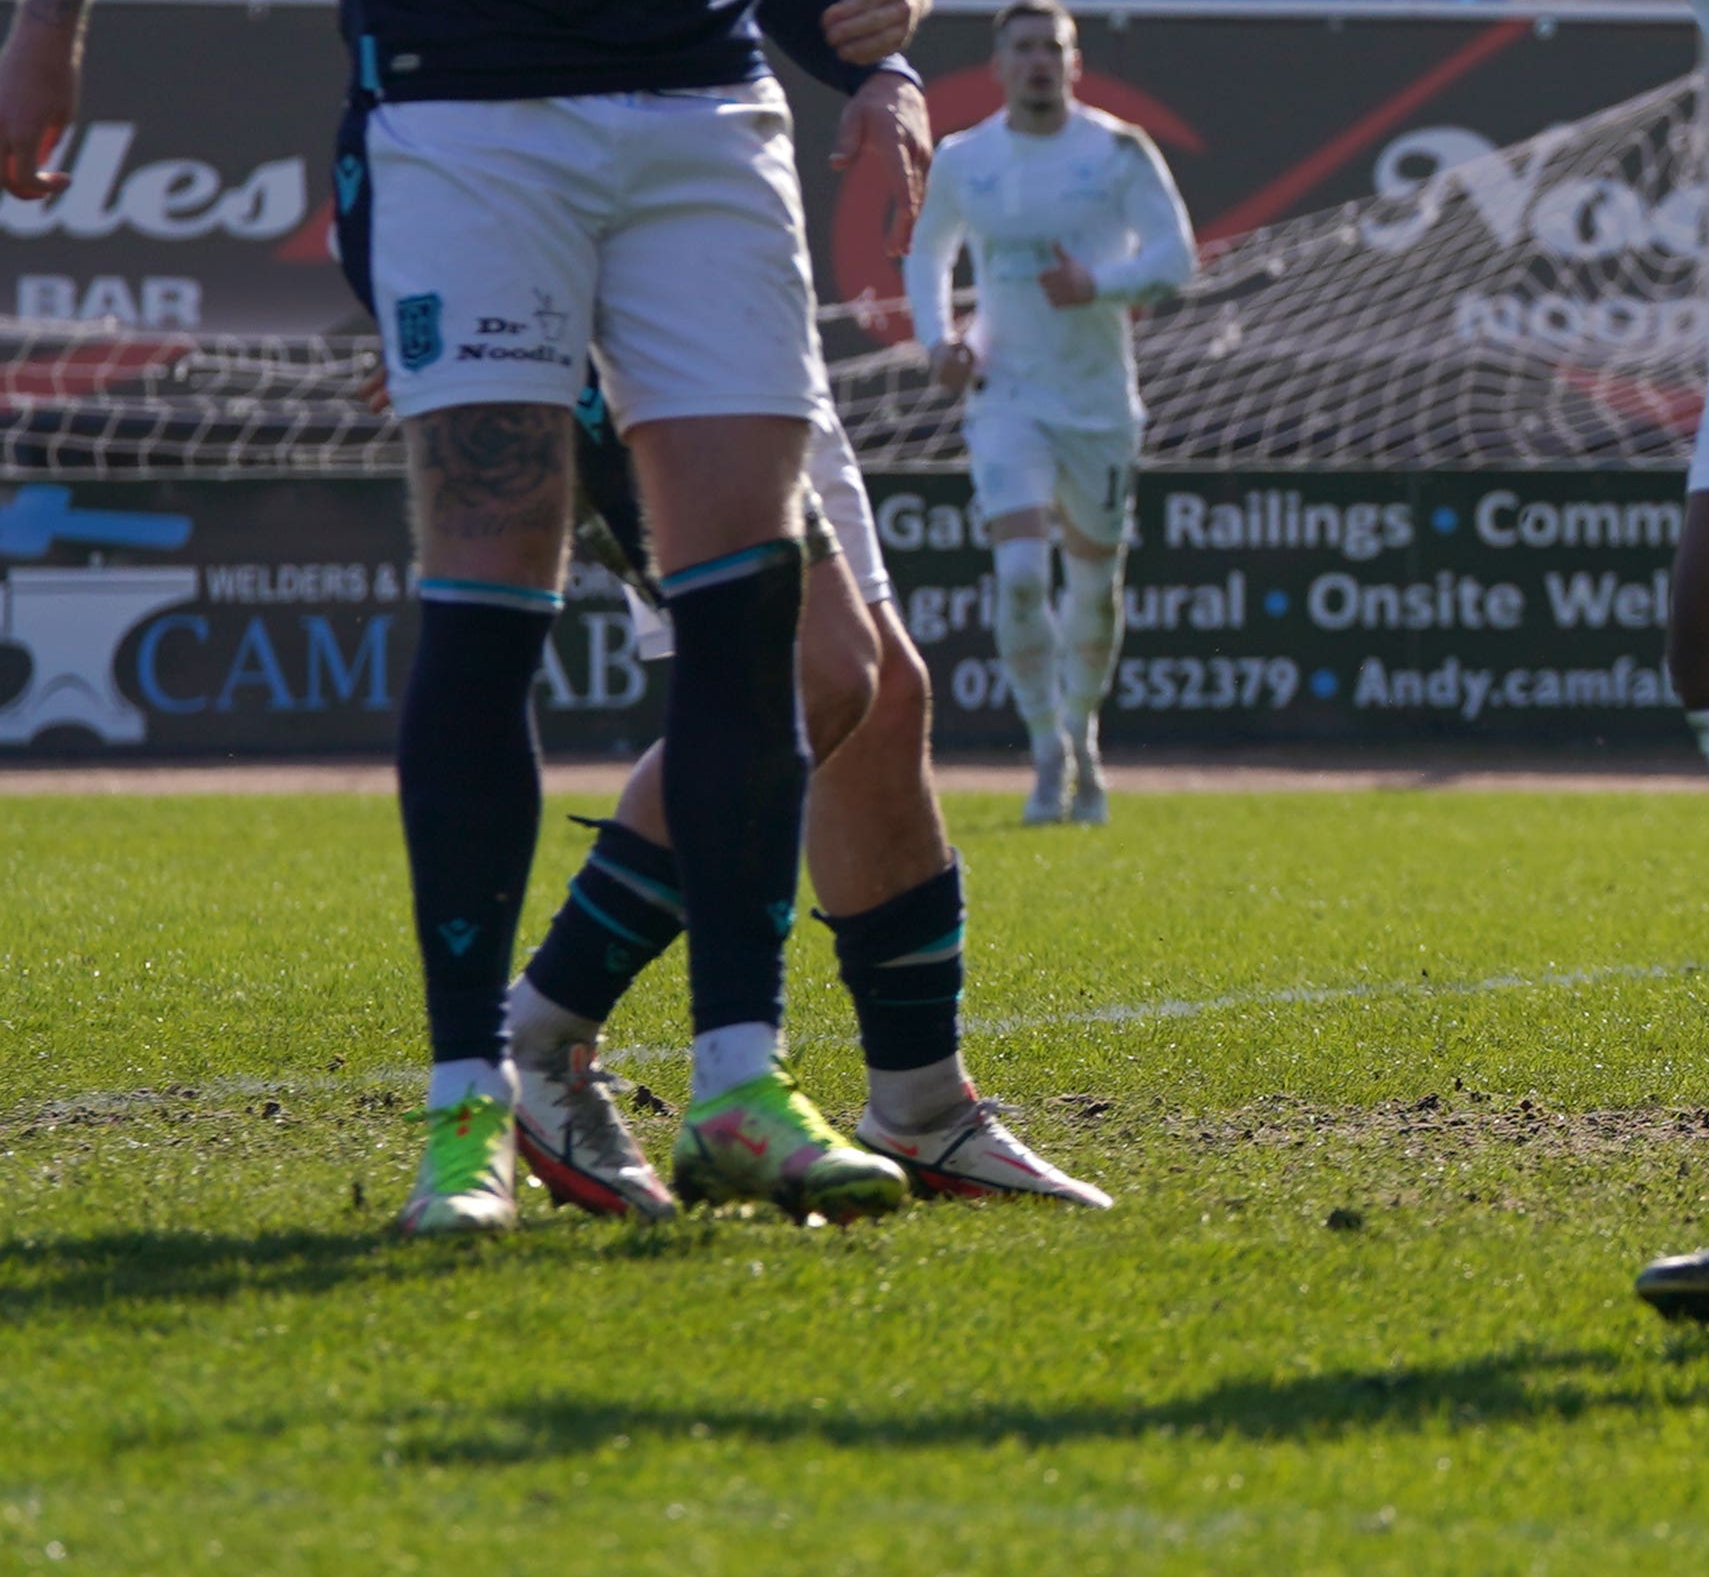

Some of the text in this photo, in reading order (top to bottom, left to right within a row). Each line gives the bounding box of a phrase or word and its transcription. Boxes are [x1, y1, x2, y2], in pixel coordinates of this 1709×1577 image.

[15, 274, 203, 328] BAR
[476, 317, 525, 335] Dr
[456, 341, 572, 367] Noodls
[1163, 488, 1415, 561] Railings
[1474, 488, 1684, 548] Comm
[205, 563, 367, 602] WELDERS
[373, 562, 401, 602] &
[1307, 570, 1526, 630] Onsite
[1545, 570, 1671, 629] Wel
[1116, 655, 1299, 711] 552379
